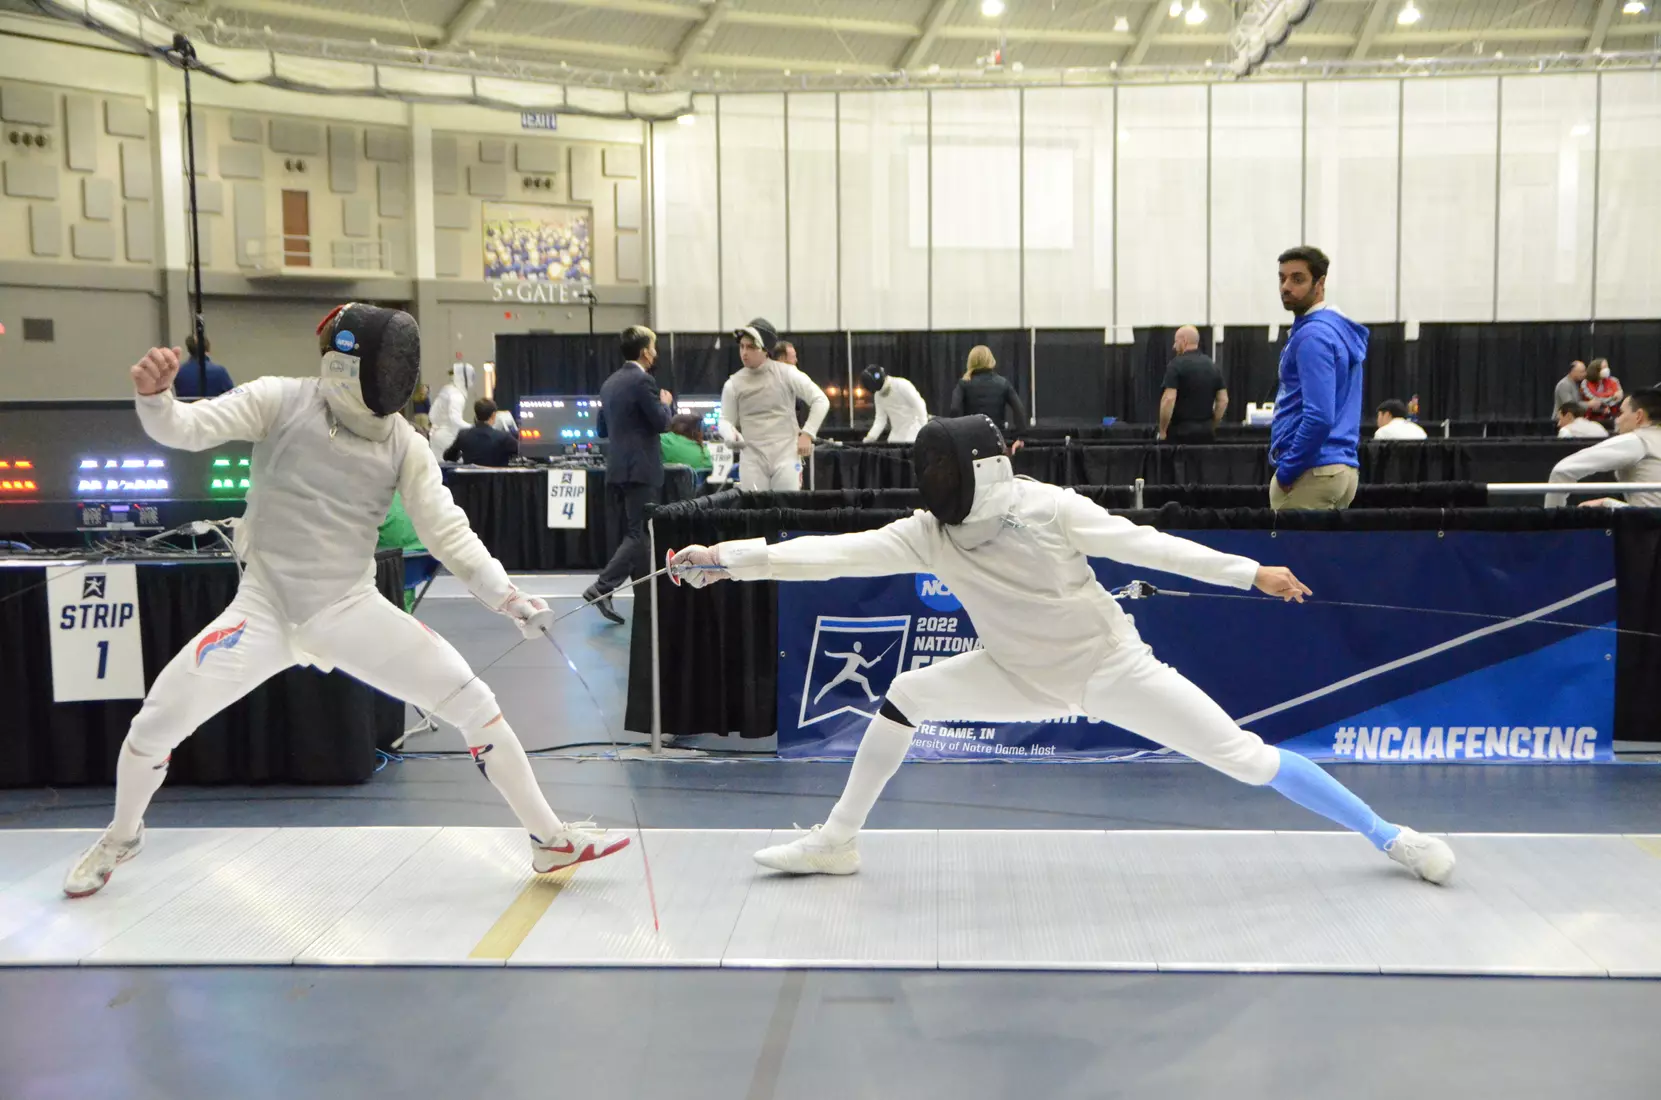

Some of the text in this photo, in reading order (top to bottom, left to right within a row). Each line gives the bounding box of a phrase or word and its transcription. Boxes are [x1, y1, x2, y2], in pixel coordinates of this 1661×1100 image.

[516, 282, 569, 303] GATE
[718, 464, 725, 476] 7
[551, 485, 585, 497] STRIP
[562, 502, 575, 520] 4
[920, 579, 951, 596] NC
[60, 603, 134, 630] STRIP
[916, 616, 958, 633] 2022
[913, 635, 984, 652] NATIONA
[96, 640, 109, 679] 1
[915, 723, 996, 741] TRE DAME, IN
[911, 738, 947, 752] versity
[948, 741, 961, 751] of
[961, 742, 993, 754] Notre
[1030, 743, 1057, 756] Host
[1332, 726, 1598, 760] #NCAAFENCING
